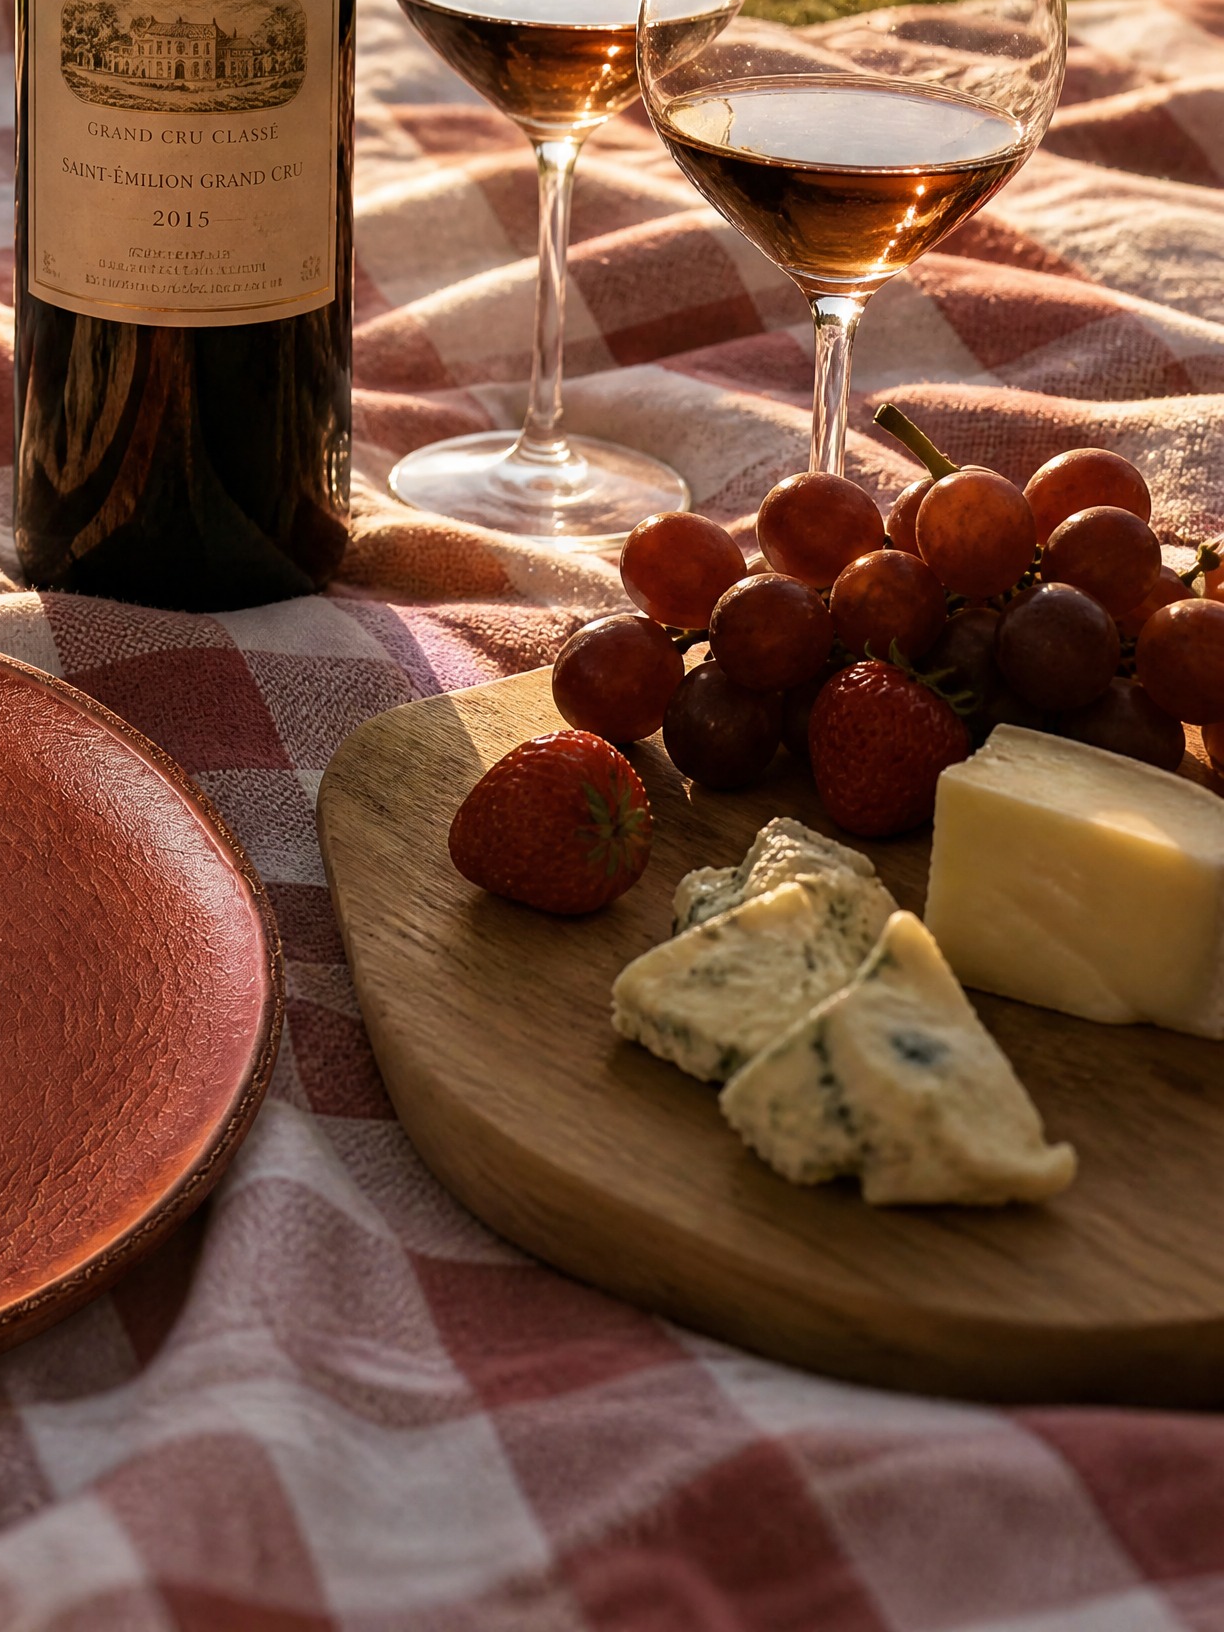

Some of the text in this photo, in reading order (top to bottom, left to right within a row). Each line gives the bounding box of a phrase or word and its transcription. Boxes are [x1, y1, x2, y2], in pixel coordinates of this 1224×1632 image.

[87, 121, 279, 145] GRAND CRU CLASSÉ
[61, 157, 304, 189] SAINT-ÉMILION GRAND CRU
[152, 210, 210, 228] 2015
